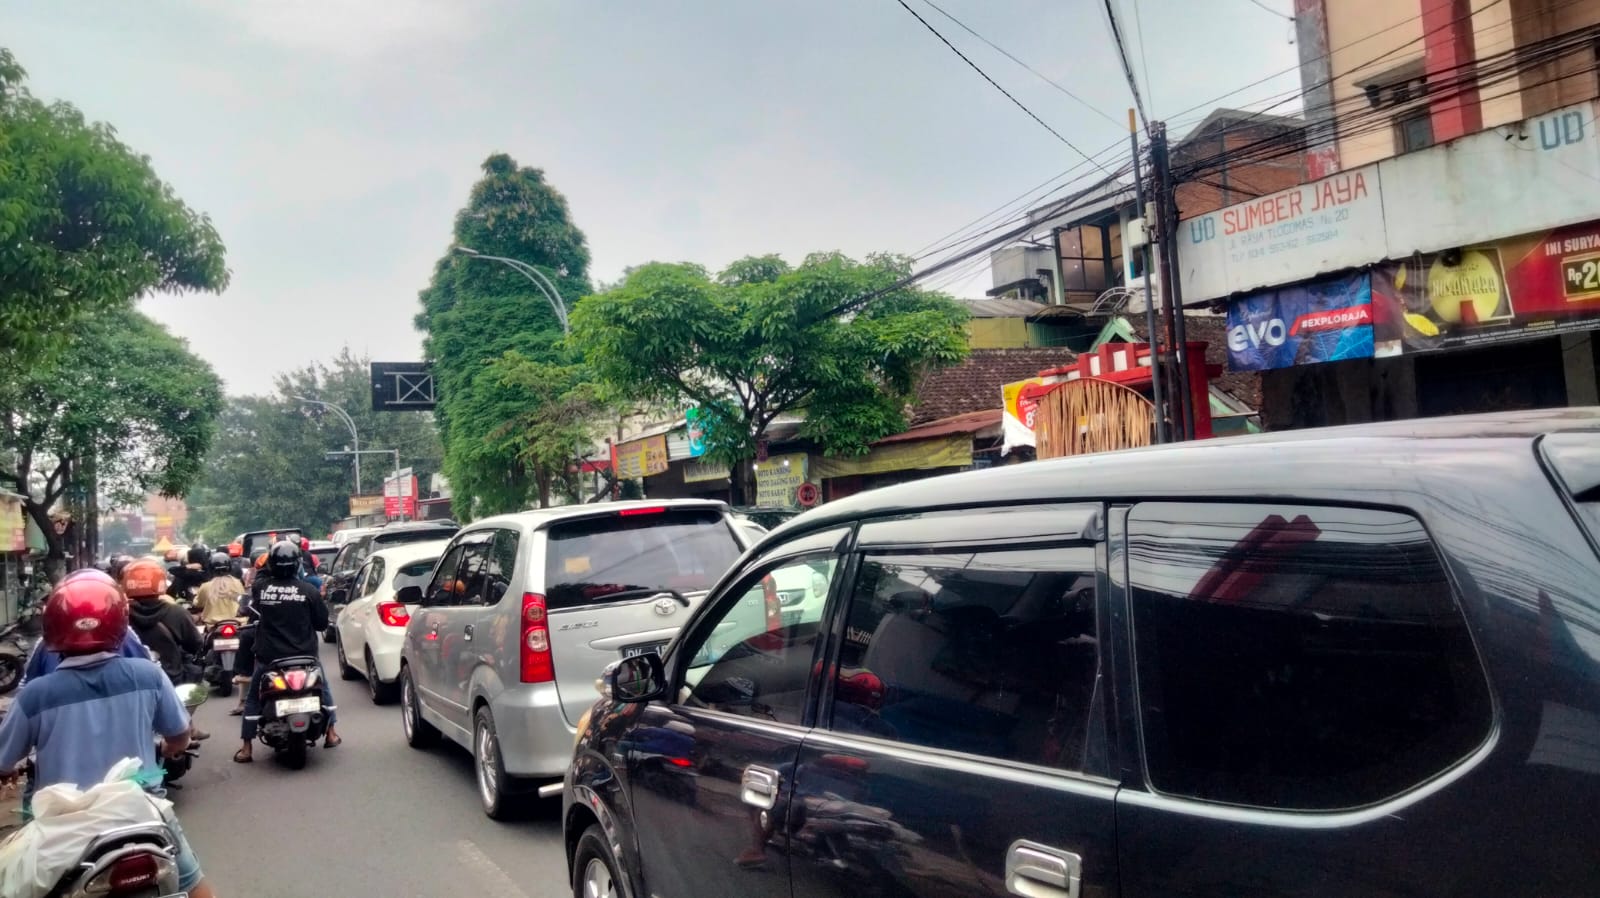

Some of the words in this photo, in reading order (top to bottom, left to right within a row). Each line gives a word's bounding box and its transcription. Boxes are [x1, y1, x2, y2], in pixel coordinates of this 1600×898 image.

[1539, 110, 1584, 151] UD
[1190, 216, 1216, 244] UD
[1223, 190, 1303, 236] SUMBER
[1311, 172, 1368, 211] JAYA
[1335, 207, 1349, 222] 20
[1545, 241, 1562, 257] INI
[1564, 233, 1600, 253] SURYA
[1301, 310, 1369, 329] #EXPLORAJA
[1227, 318, 1286, 353] evo
[260, 589, 278, 600] the
[265, 584, 299, 594] break
[120, 873, 150, 885] SUZUKI
